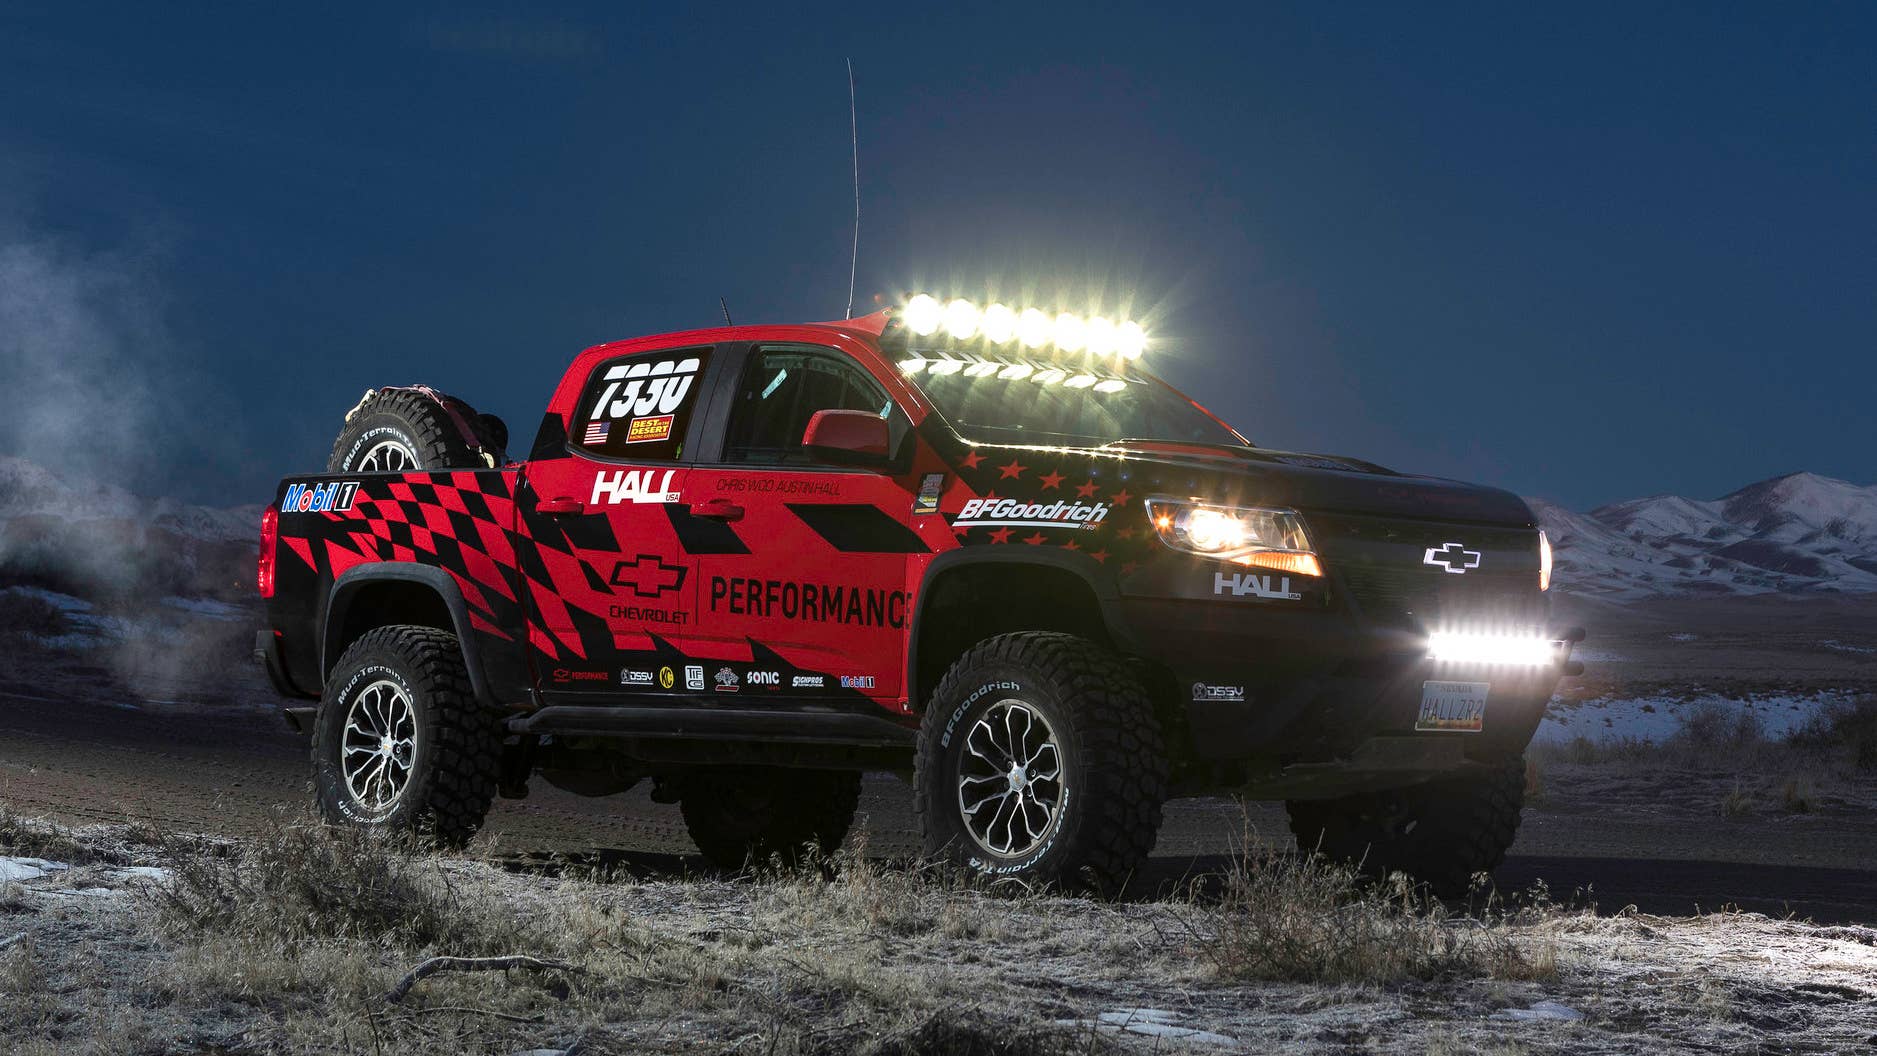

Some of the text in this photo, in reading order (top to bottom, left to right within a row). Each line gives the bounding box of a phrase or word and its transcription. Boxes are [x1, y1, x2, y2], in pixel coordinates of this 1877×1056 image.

[631, 425, 669, 435] DESERT
[632, 419, 660, 428] BEST
[282, 482, 340, 512] Mobil
[590, 470, 677, 505] HALL
[815, 481, 841, 497] HALL
[957, 499, 1108, 523] BFGoodrich
[1214, 572, 1290, 599] HALL
[609, 605, 689, 625] CHEVROLET
[629, 671, 654, 681] DSSV
[661, 667, 674, 687] KC
[841, 675, 865, 688] Mobil
[1207, 686, 1244, 697] DSSV
[941, 681, 1021, 749] BFGoodrich
